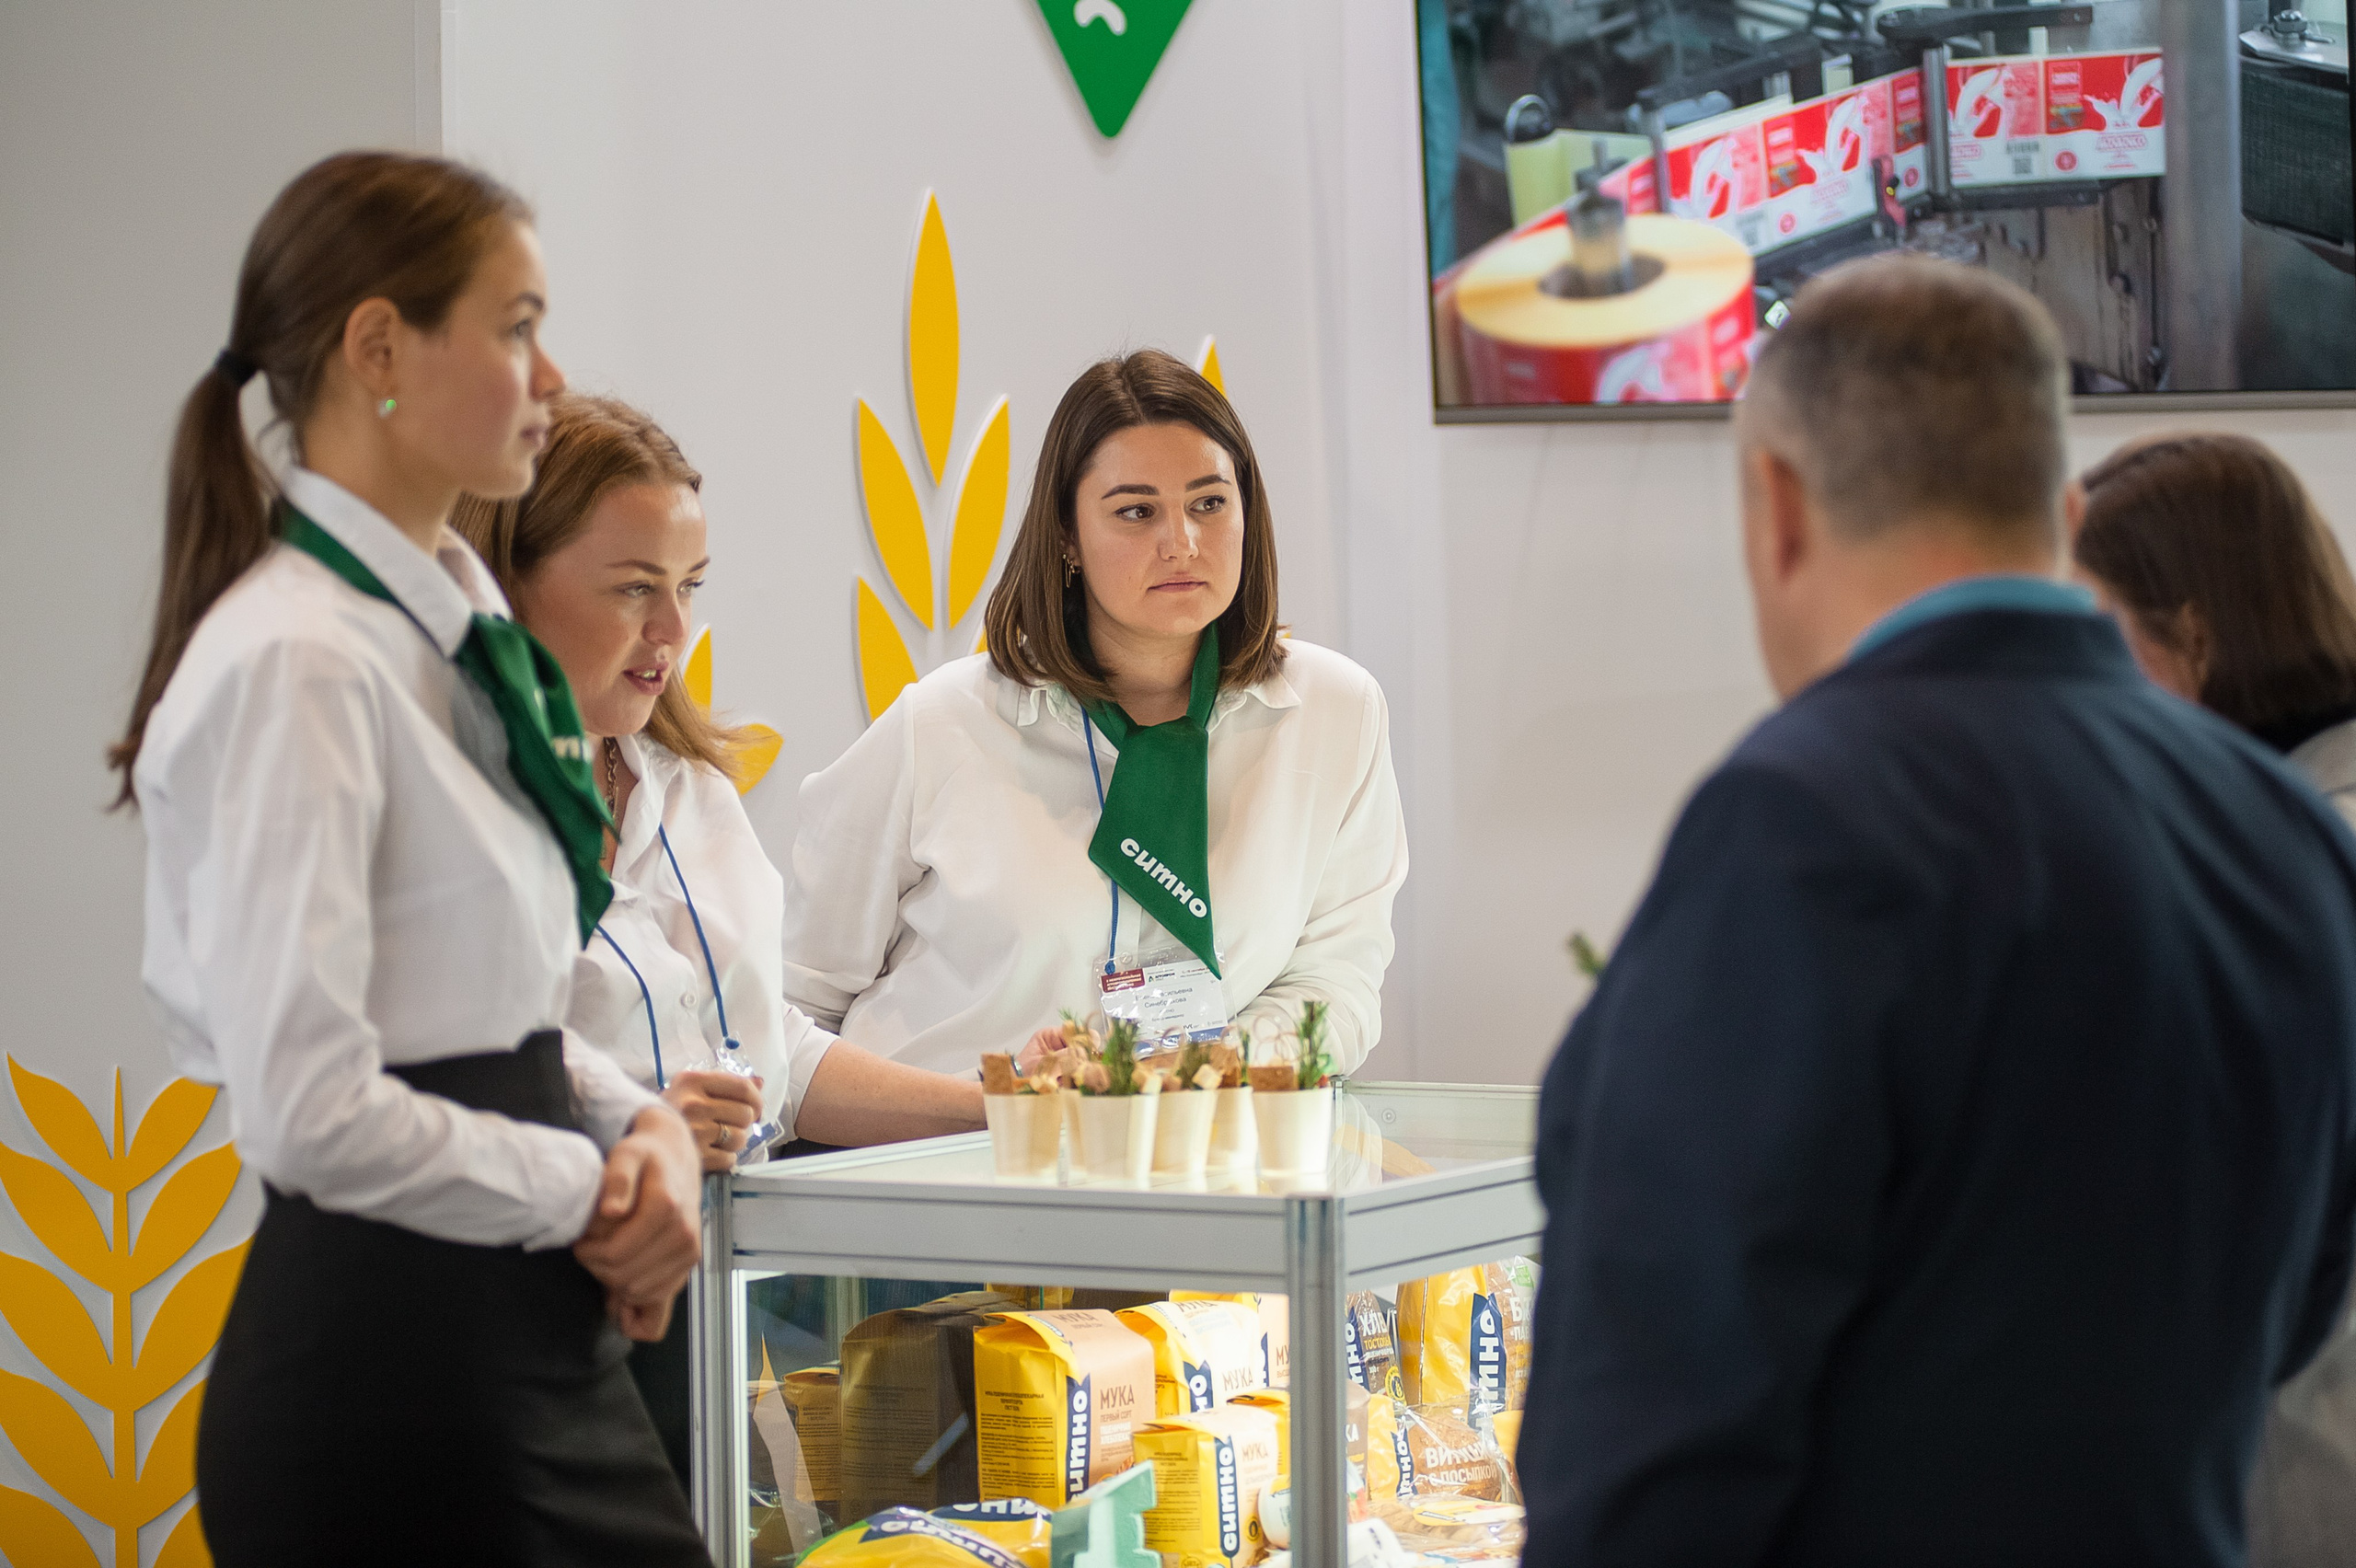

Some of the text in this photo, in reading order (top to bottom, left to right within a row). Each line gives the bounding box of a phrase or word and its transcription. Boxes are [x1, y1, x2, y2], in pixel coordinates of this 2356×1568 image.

[1120, 837, 1207, 918] ситно
[1144, 997, 1187, 1009] Синебрхова
[1276, 1344, 1289, 1366] МУ
[1222, 1366, 1253, 1391] МУКА
[1100, 1384, 1135, 1410] МУКА
[1218, 1446, 1238, 1552] ситно
